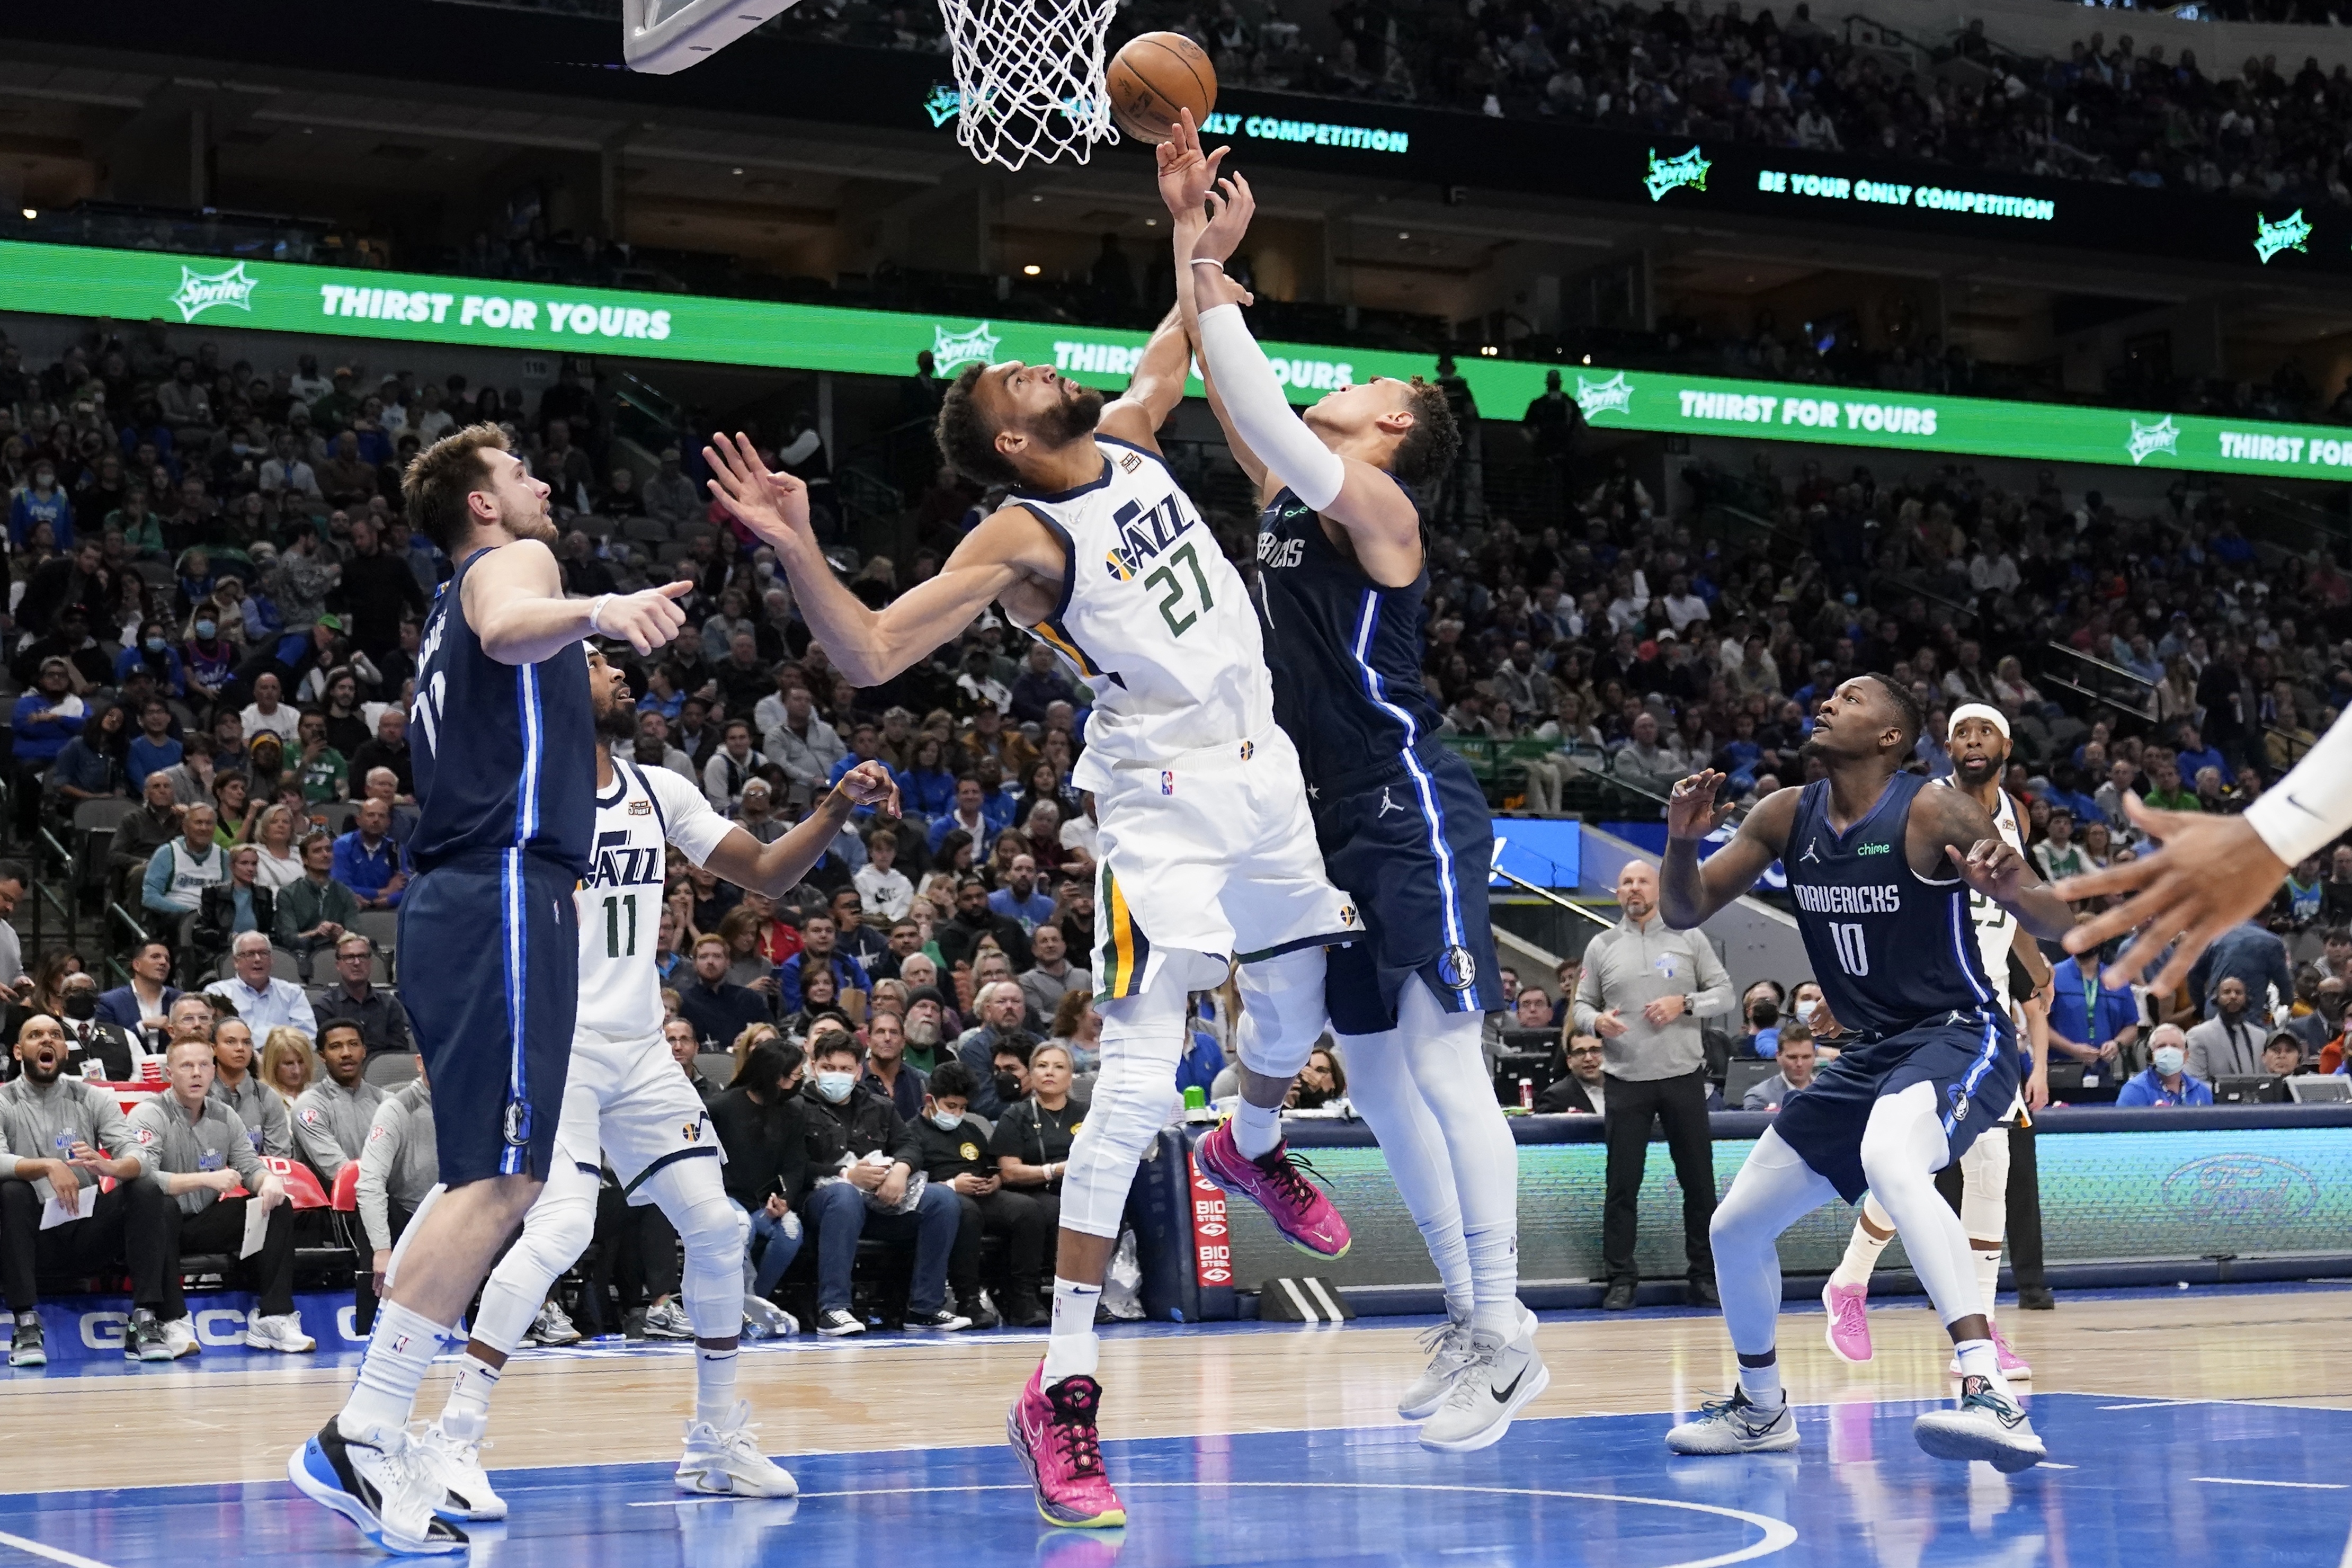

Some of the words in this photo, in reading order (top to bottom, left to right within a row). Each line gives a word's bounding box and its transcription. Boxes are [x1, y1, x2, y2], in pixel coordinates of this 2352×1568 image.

[1245, 115, 1409, 154] COMPETITION
[1758, 170, 1787, 193] BE
[1790, 173, 1850, 200] YOUR
[1854, 179, 1912, 206] ONLY
[1914, 185, 2055, 220] COMPETITION
[181, 278, 246, 306] Sprite
[321, 284, 453, 323] THIRST
[460, 295, 538, 331] FOR
[547, 301, 671, 340] YOURS
[936, 336, 992, 363] Sprite
[1580, 387, 1626, 408] Sprite
[1679, 390, 1777, 423] THIRST
[1782, 398, 1839, 428] FOR
[1844, 403, 1937, 435] YOURS
[2219, 431, 2304, 463] THIRST
[1112, 491, 1195, 570] JAZZ
[1144, 541, 1214, 638] 27
[579, 830, 663, 891] JAZZ
[1857, 843, 1890, 856] chime
[1793, 884, 1901, 914] MAVERICKS
[602, 894, 636, 958] 11
[1829, 922, 1869, 976] 10
[1196, 1200, 1226, 1215] BIO
[1199, 1245, 1230, 1260] BIO
